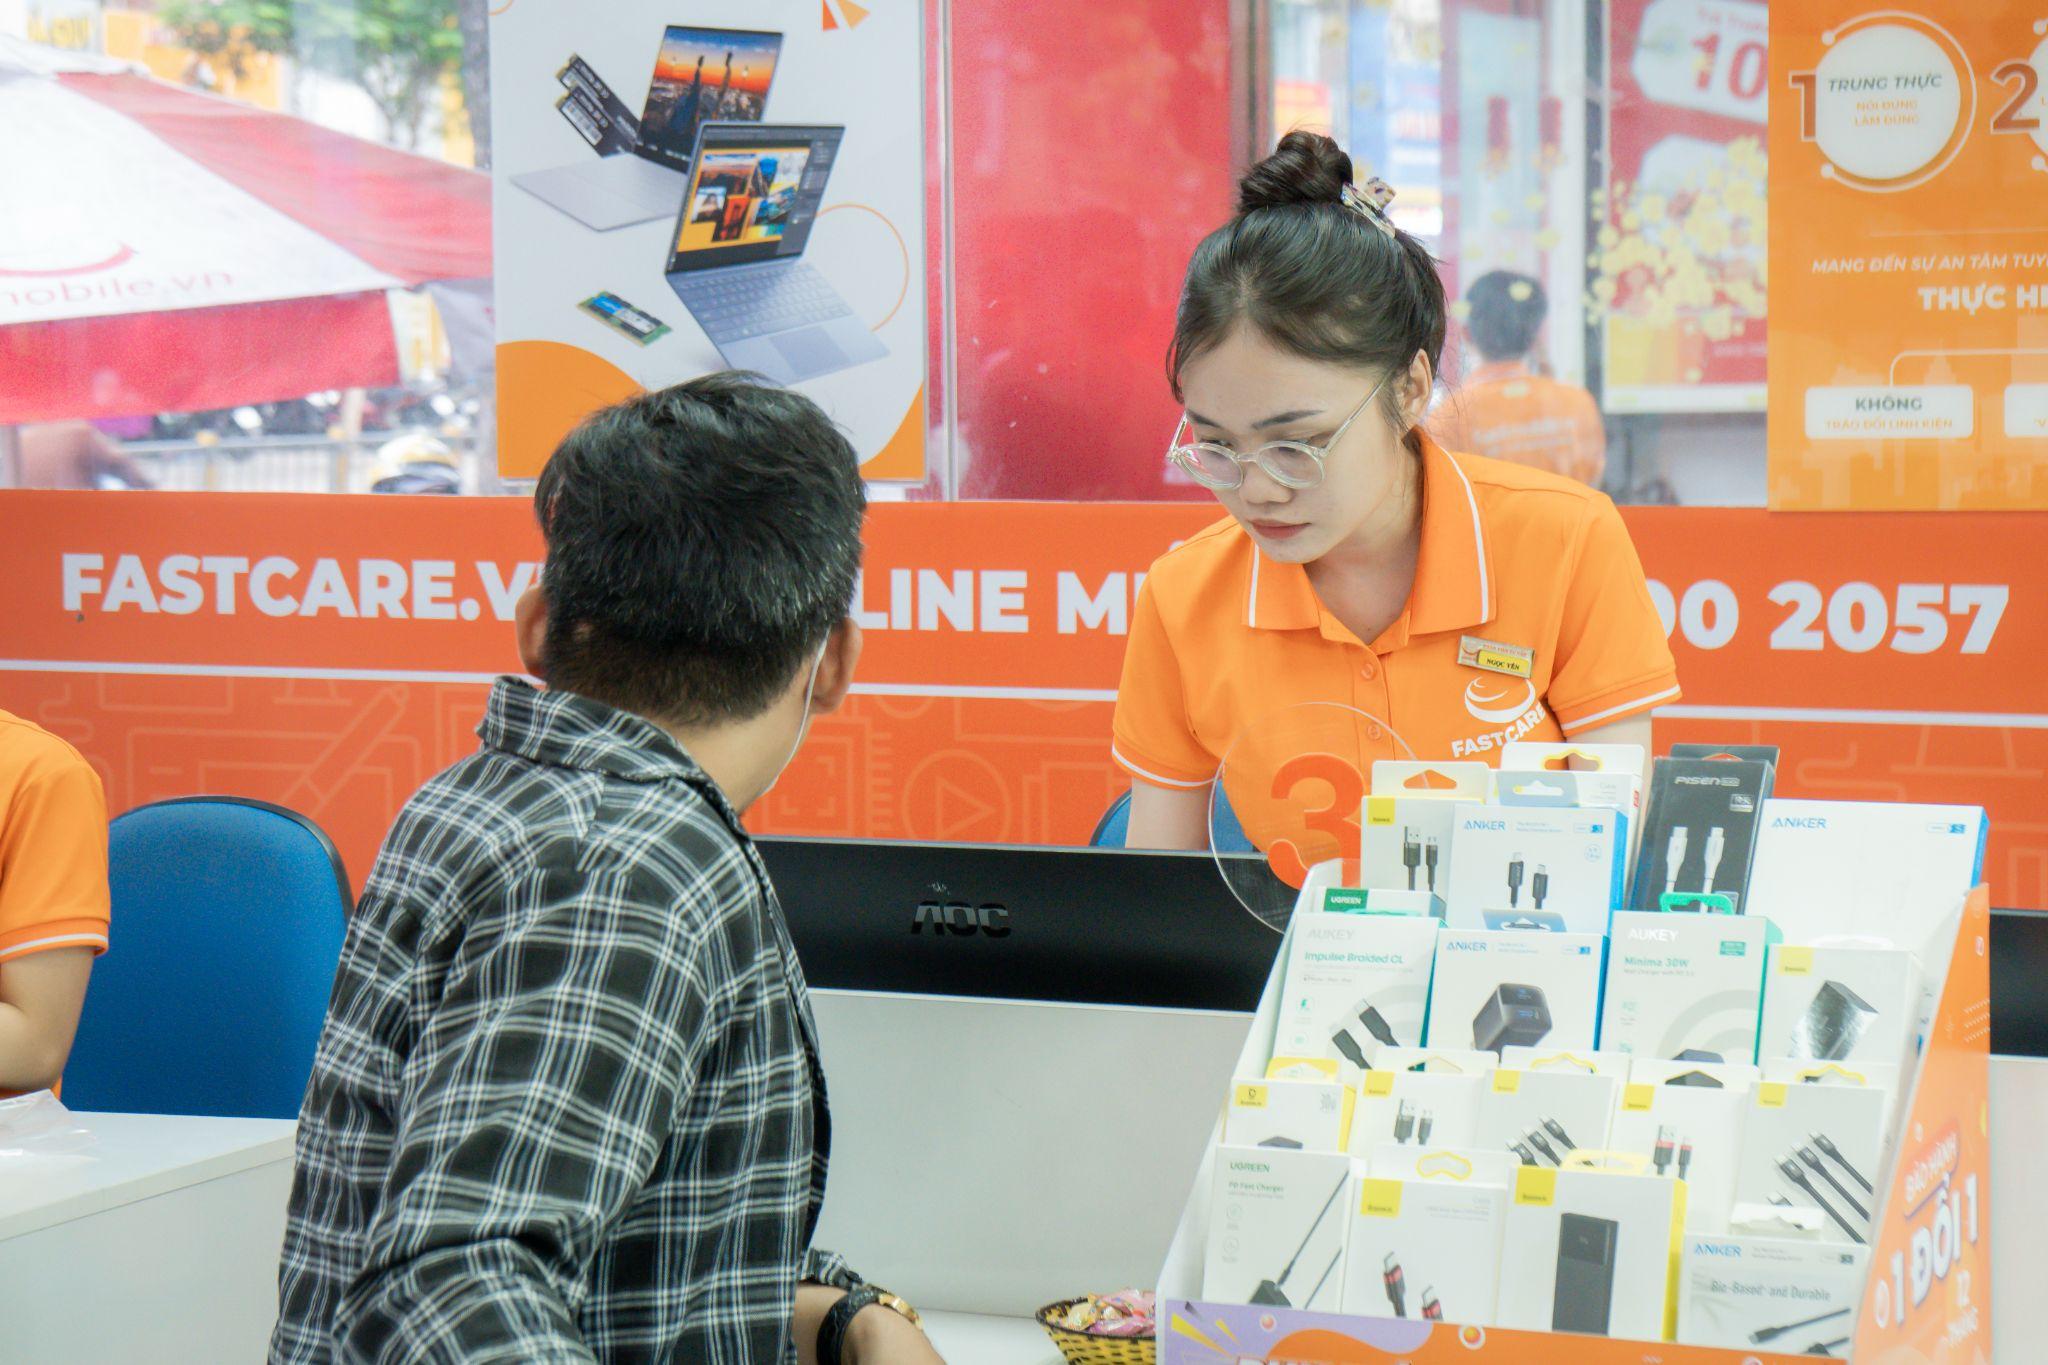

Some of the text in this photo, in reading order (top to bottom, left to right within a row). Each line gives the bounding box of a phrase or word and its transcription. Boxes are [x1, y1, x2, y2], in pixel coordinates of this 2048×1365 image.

[1828, 70, 1943, 92] TRUNG THỰC
[1991, 58, 2041, 134] 2
[1811, 251, 2048, 275] MANG ĐẾN SỰ AN TÂM TUY
[1917, 281, 2006, 317] THỰC
[1855, 394, 1923, 412] KHÔNG
[61, 553, 546, 621] FASTCARE.V
[1767, 580, 2010, 654] 2057
[1451, 701, 1546, 758] FASTCARE
[1267, 753, 1365, 890] 3
[1464, 820, 1506, 831] ANKER
[1772, 817, 1827, 830] ANKER
[1331, 896, 1362, 905] UGREEN
[910, 901, 1012, 938] AOC
[1308, 929, 1355, 941] AUKEY
[1628, 928, 1680, 942] AUKEY
[1446, 941, 1488, 952] ANKER
[1305, 951, 1346, 963] Impulse
[1347, 952, 1389, 964] Braided
[1624, 956, 1663, 967] Minima
[1694, 1243, 1742, 1257] ANKER
[1891, 1250, 1904, 1324] 1
[1964, 1172, 1978, 1263] 1
[1768, 1284, 1788, 1297] and
[1791, 1286, 1832, 1302] Durable
